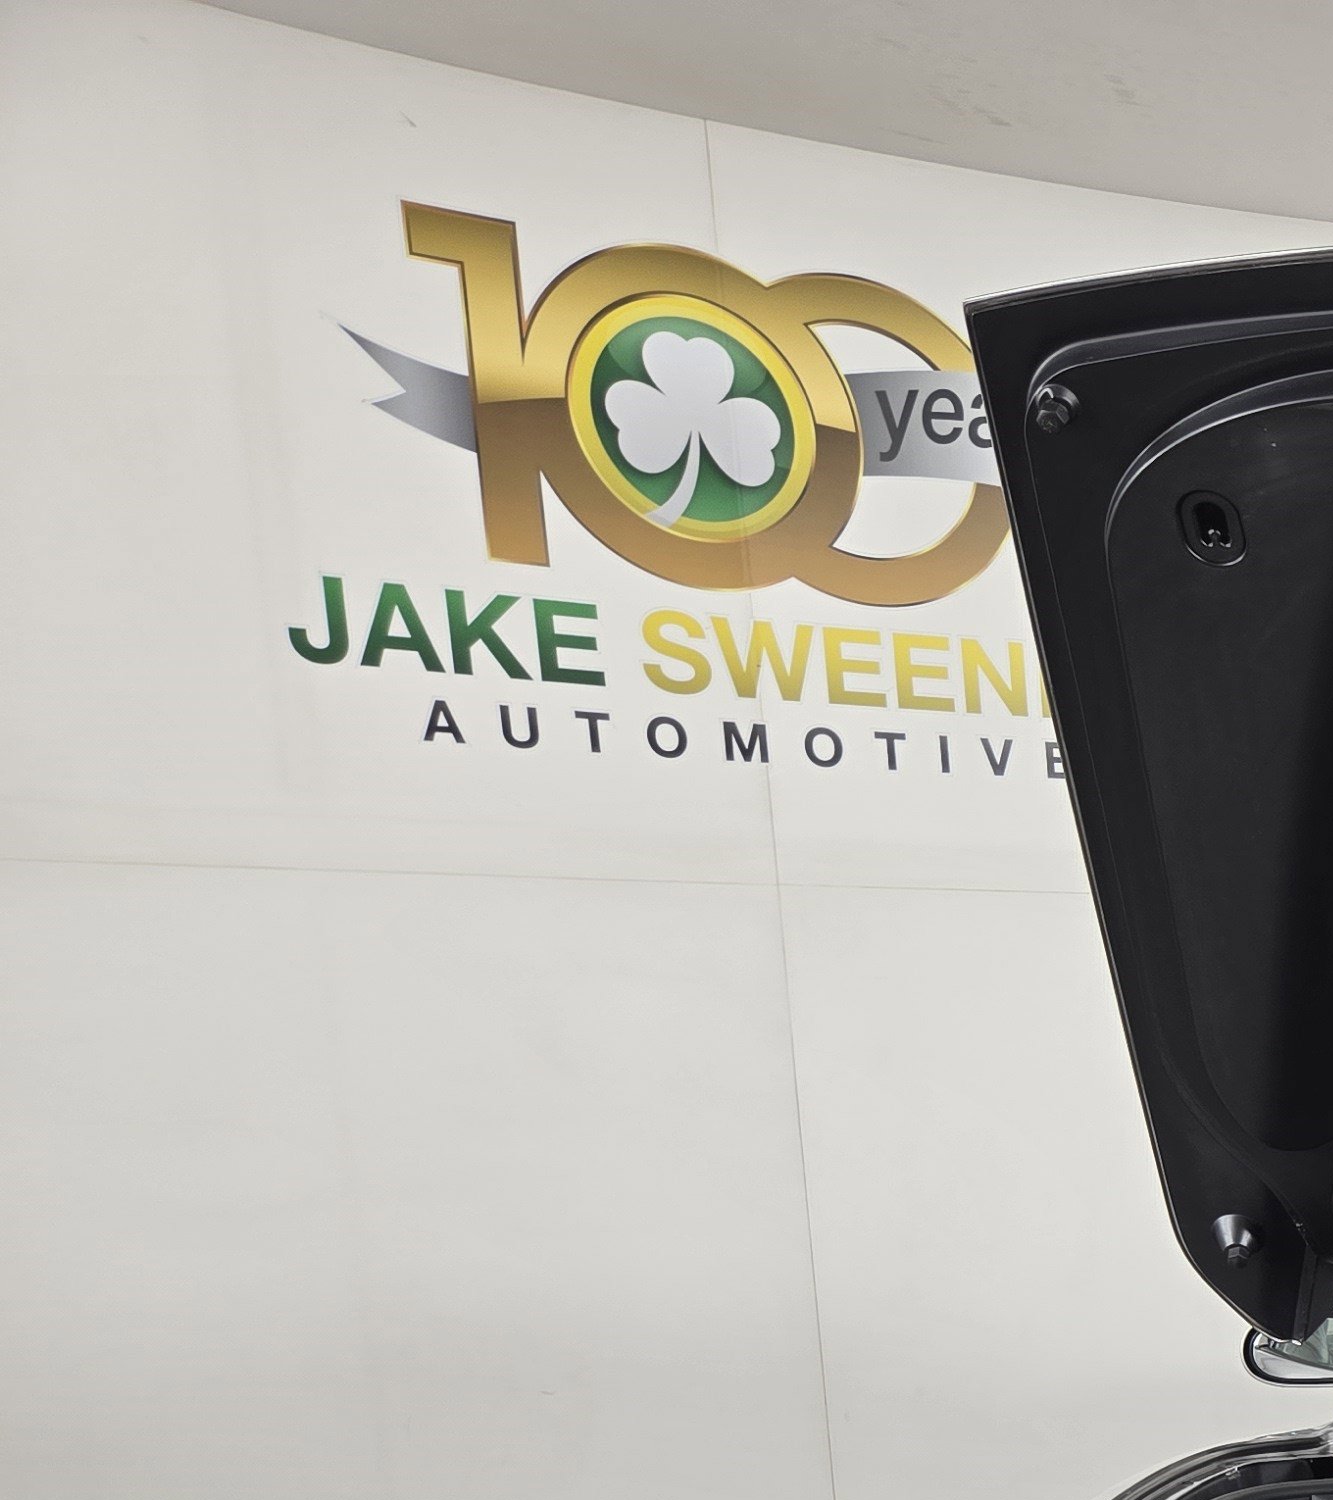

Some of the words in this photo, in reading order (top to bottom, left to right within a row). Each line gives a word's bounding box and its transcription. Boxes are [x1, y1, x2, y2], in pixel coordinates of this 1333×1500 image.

[400, 200, 1010, 608] 100
[875, 389, 992, 462] yea
[288, 575, 607, 688] JAKE
[641, 609, 1053, 719] SWEEN
[422, 700, 1067, 780] AUTOMOTIVE
